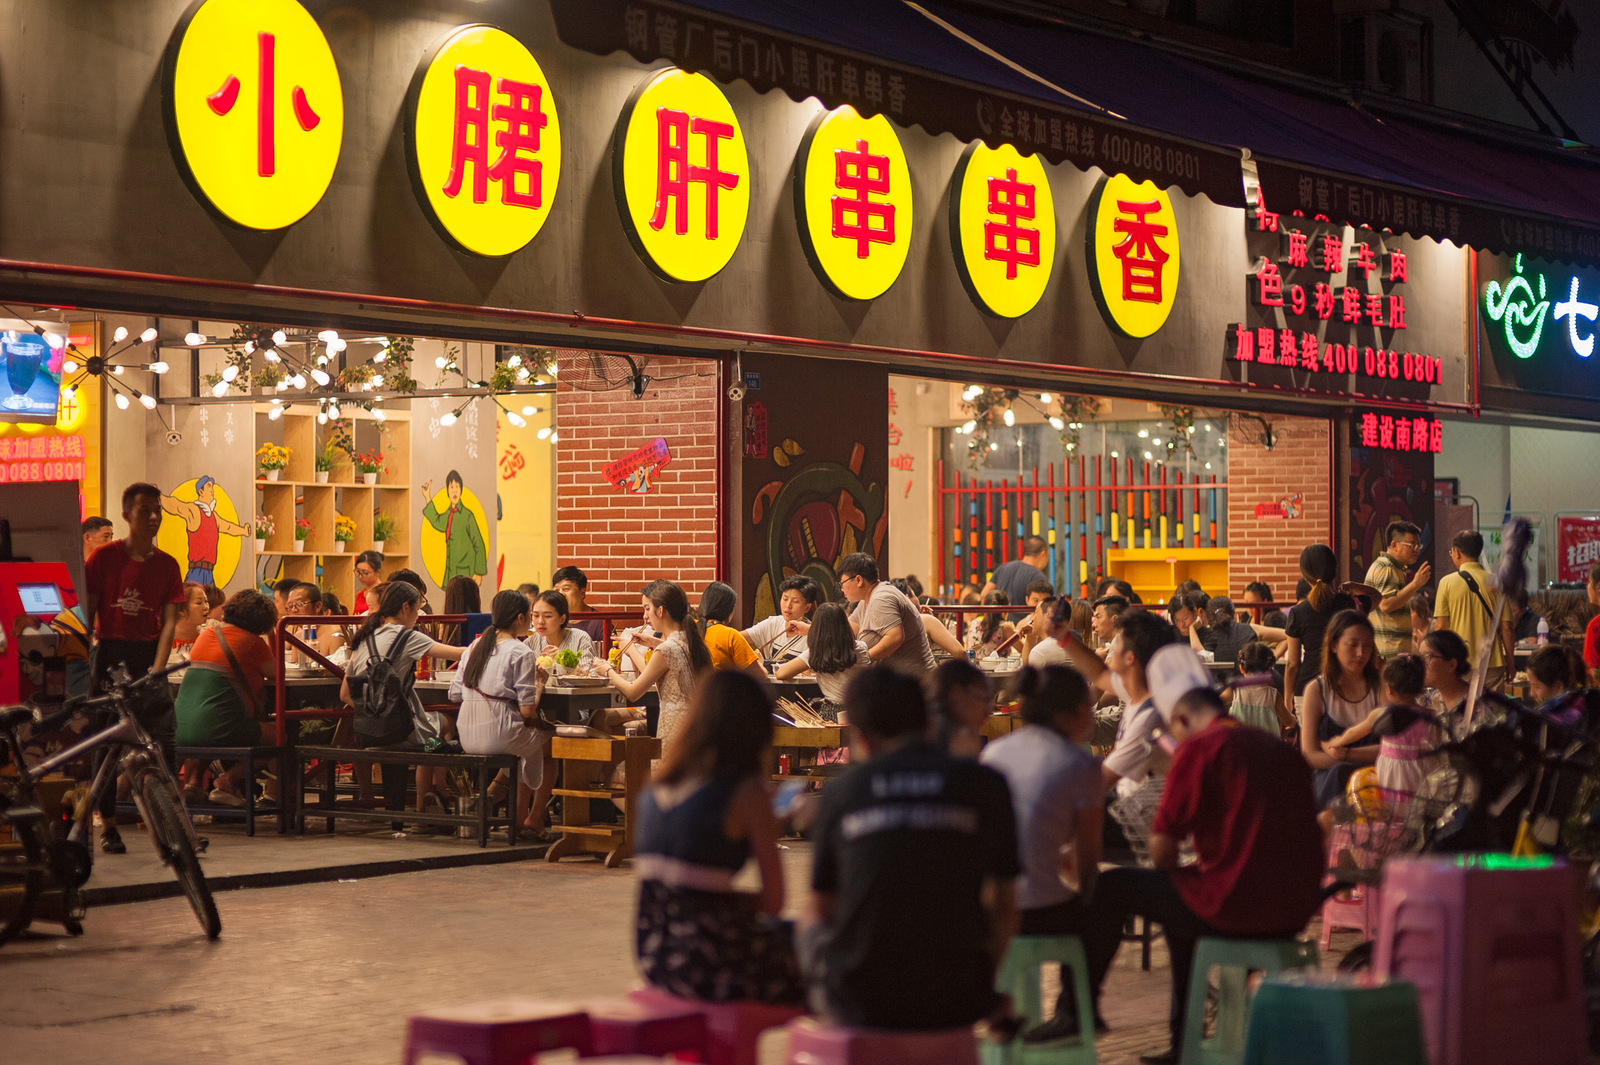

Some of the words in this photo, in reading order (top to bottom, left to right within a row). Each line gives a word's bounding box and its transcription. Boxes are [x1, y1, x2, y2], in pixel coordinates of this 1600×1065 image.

[1001, 105, 1096, 158] 全球加盟热线
[1102, 133, 1131, 165] 400
[1134, 141, 1163, 172] 088
[1167, 149, 1200, 181] 0801
[1288, 229, 1408, 284] 麻辣牛肉
[1236, 323, 1319, 373] 加盟热线
[1323, 343, 1358, 374] 400
[1364, 346, 1399, 379] 088
[1403, 352, 1443, 385] 0801
[1362, 412, 1443, 453] 建设南路店
[44, 462, 84, 481] 0801
